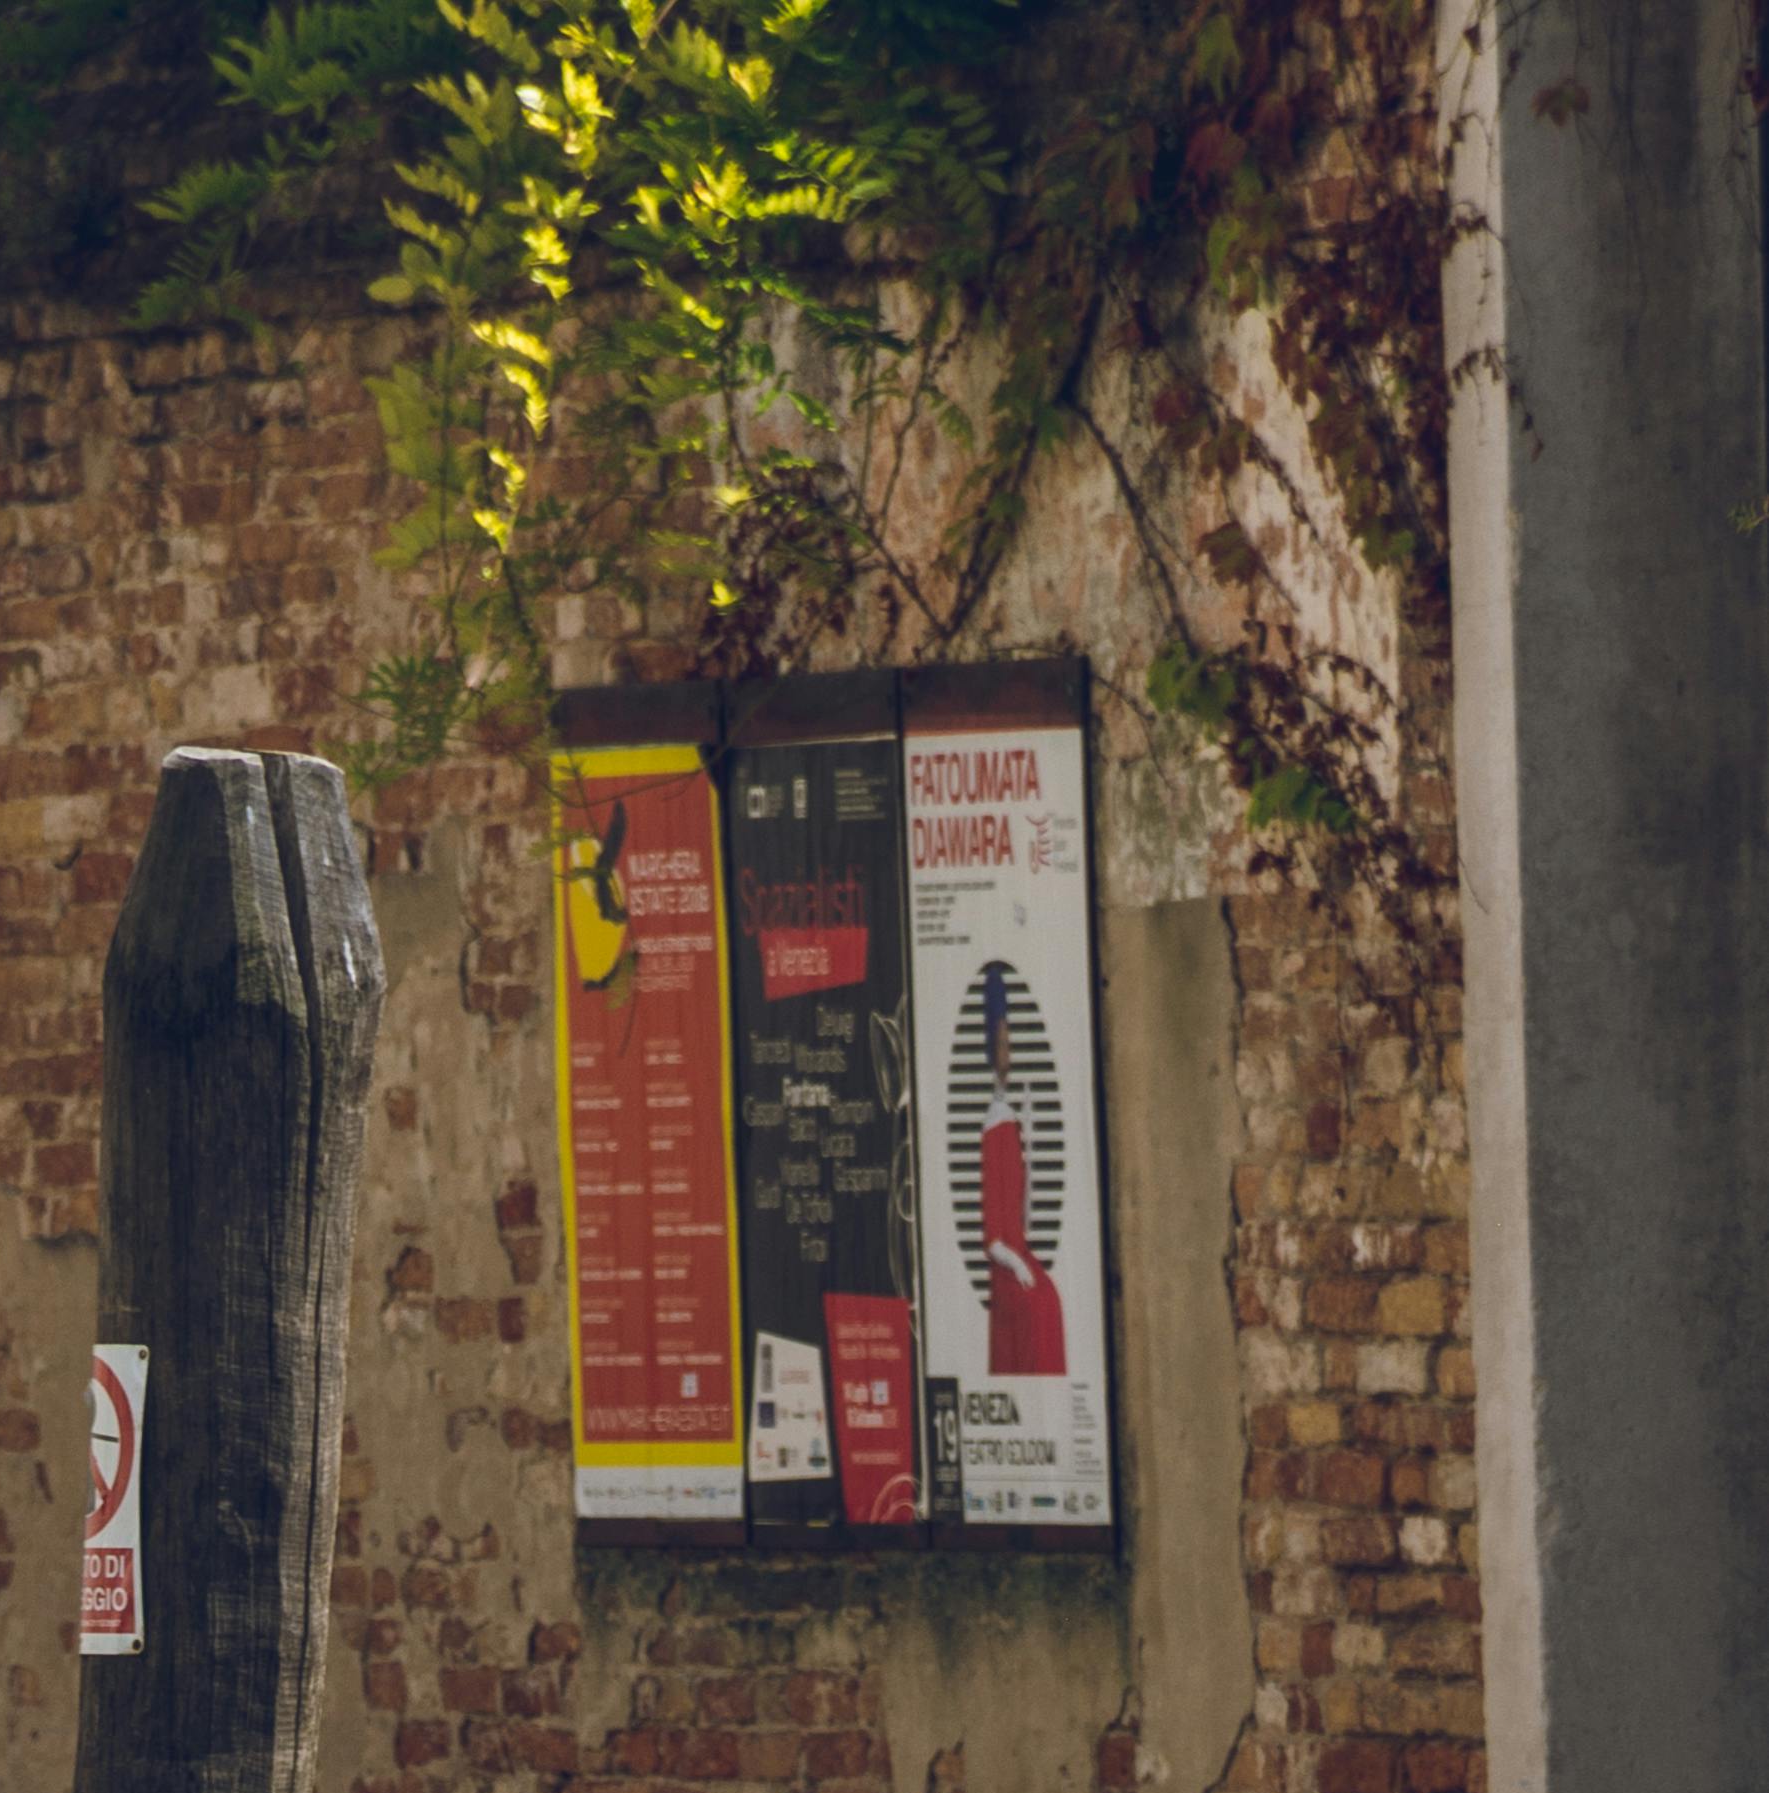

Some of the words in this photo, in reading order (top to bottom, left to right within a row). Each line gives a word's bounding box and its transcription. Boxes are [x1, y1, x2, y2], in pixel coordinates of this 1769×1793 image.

[910, 750, 1040, 805] FATOUMATA
[912, 814, 1015, 869] DIAWARA
[934, 1409, 958, 1463] 19
[959, 1392, 1020, 1426] VENEZIA
[105, 1554, 126, 1578] DI
